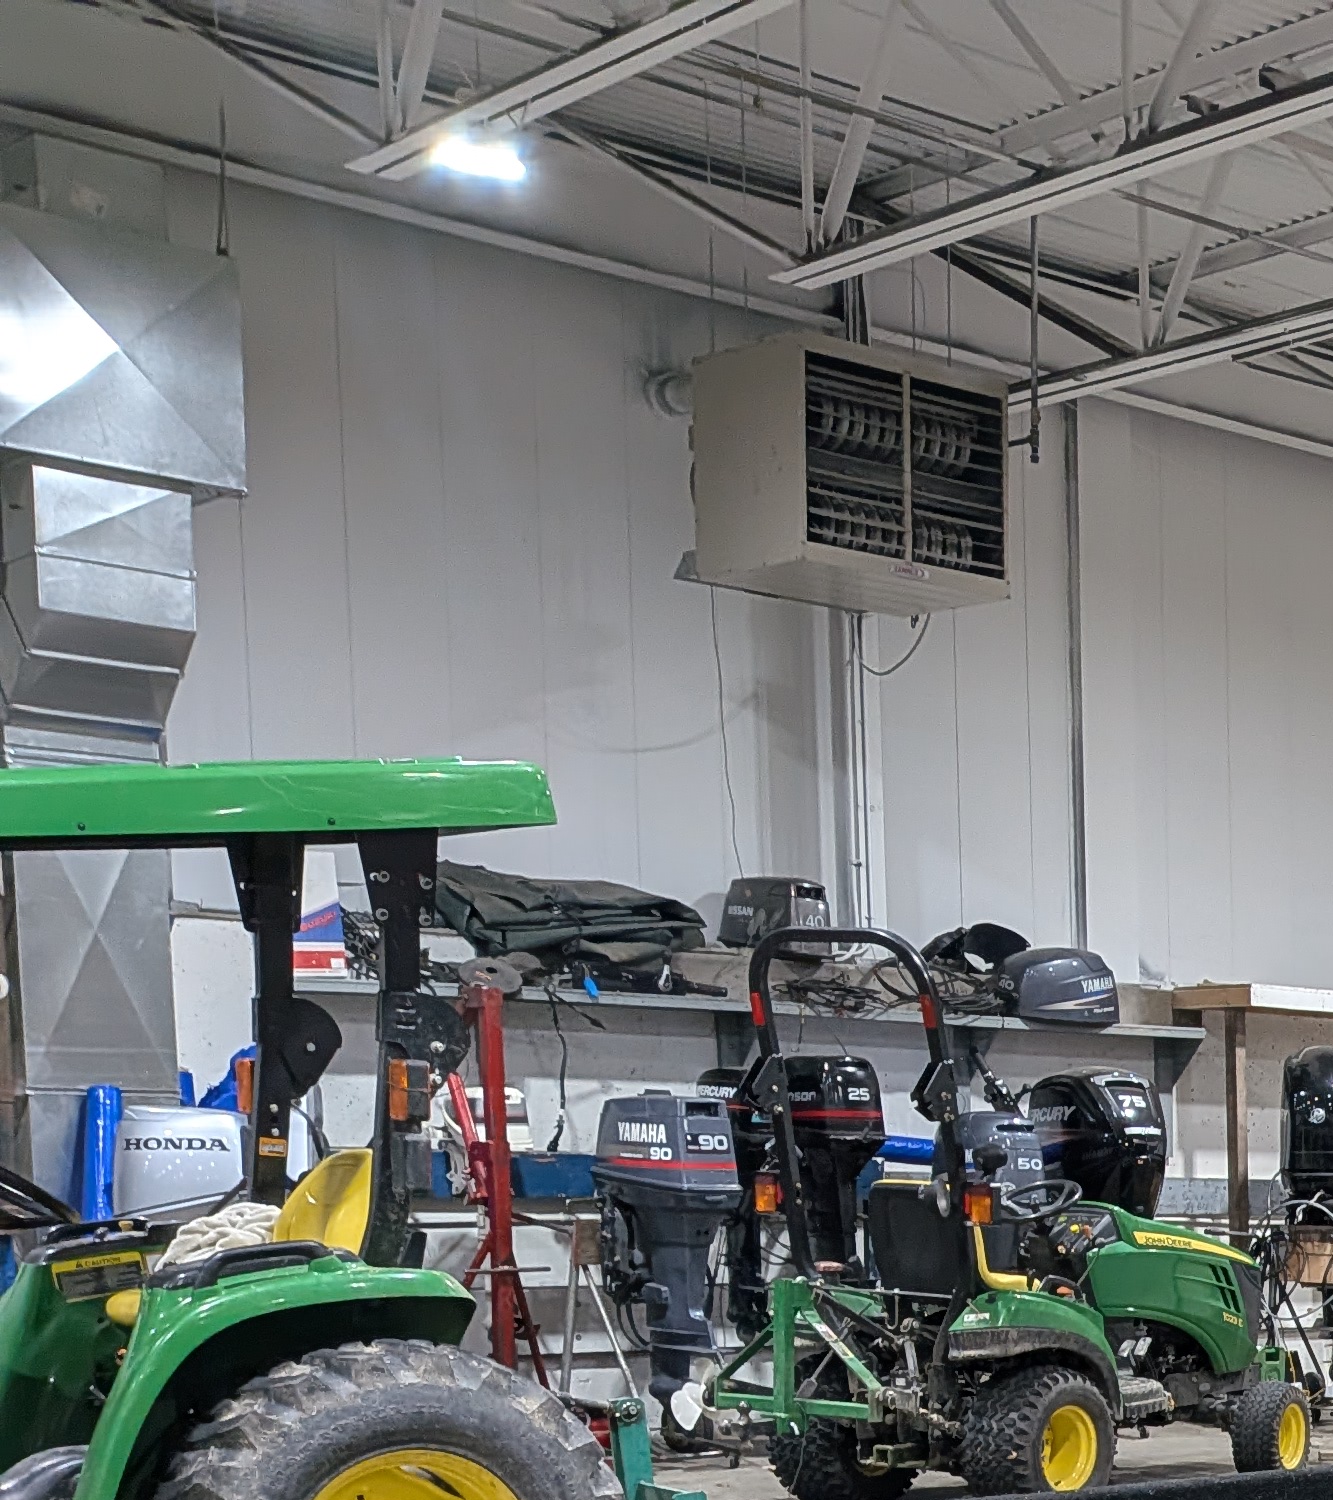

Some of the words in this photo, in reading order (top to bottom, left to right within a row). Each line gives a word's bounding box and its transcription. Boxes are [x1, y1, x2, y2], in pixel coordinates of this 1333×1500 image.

[806, 914, 825, 927] 40
[1081, 975, 1114, 994] YAMAHA
[787, 1091, 817, 1102] nson
[848, 1087, 870, 1101] 25
[1118, 1094, 1147, 1108] 75
[1029, 1105, 1077, 1121] RCURY
[618, 1121, 667, 1144] YAMAHA
[123, 1137, 231, 1151] HONDA
[698, 1134, 729, 1151] 90
[649, 1146, 673, 1161] 90
[1017, 1157, 1043, 1171] 50
[1144, 1235, 1166, 1246] JOHN
